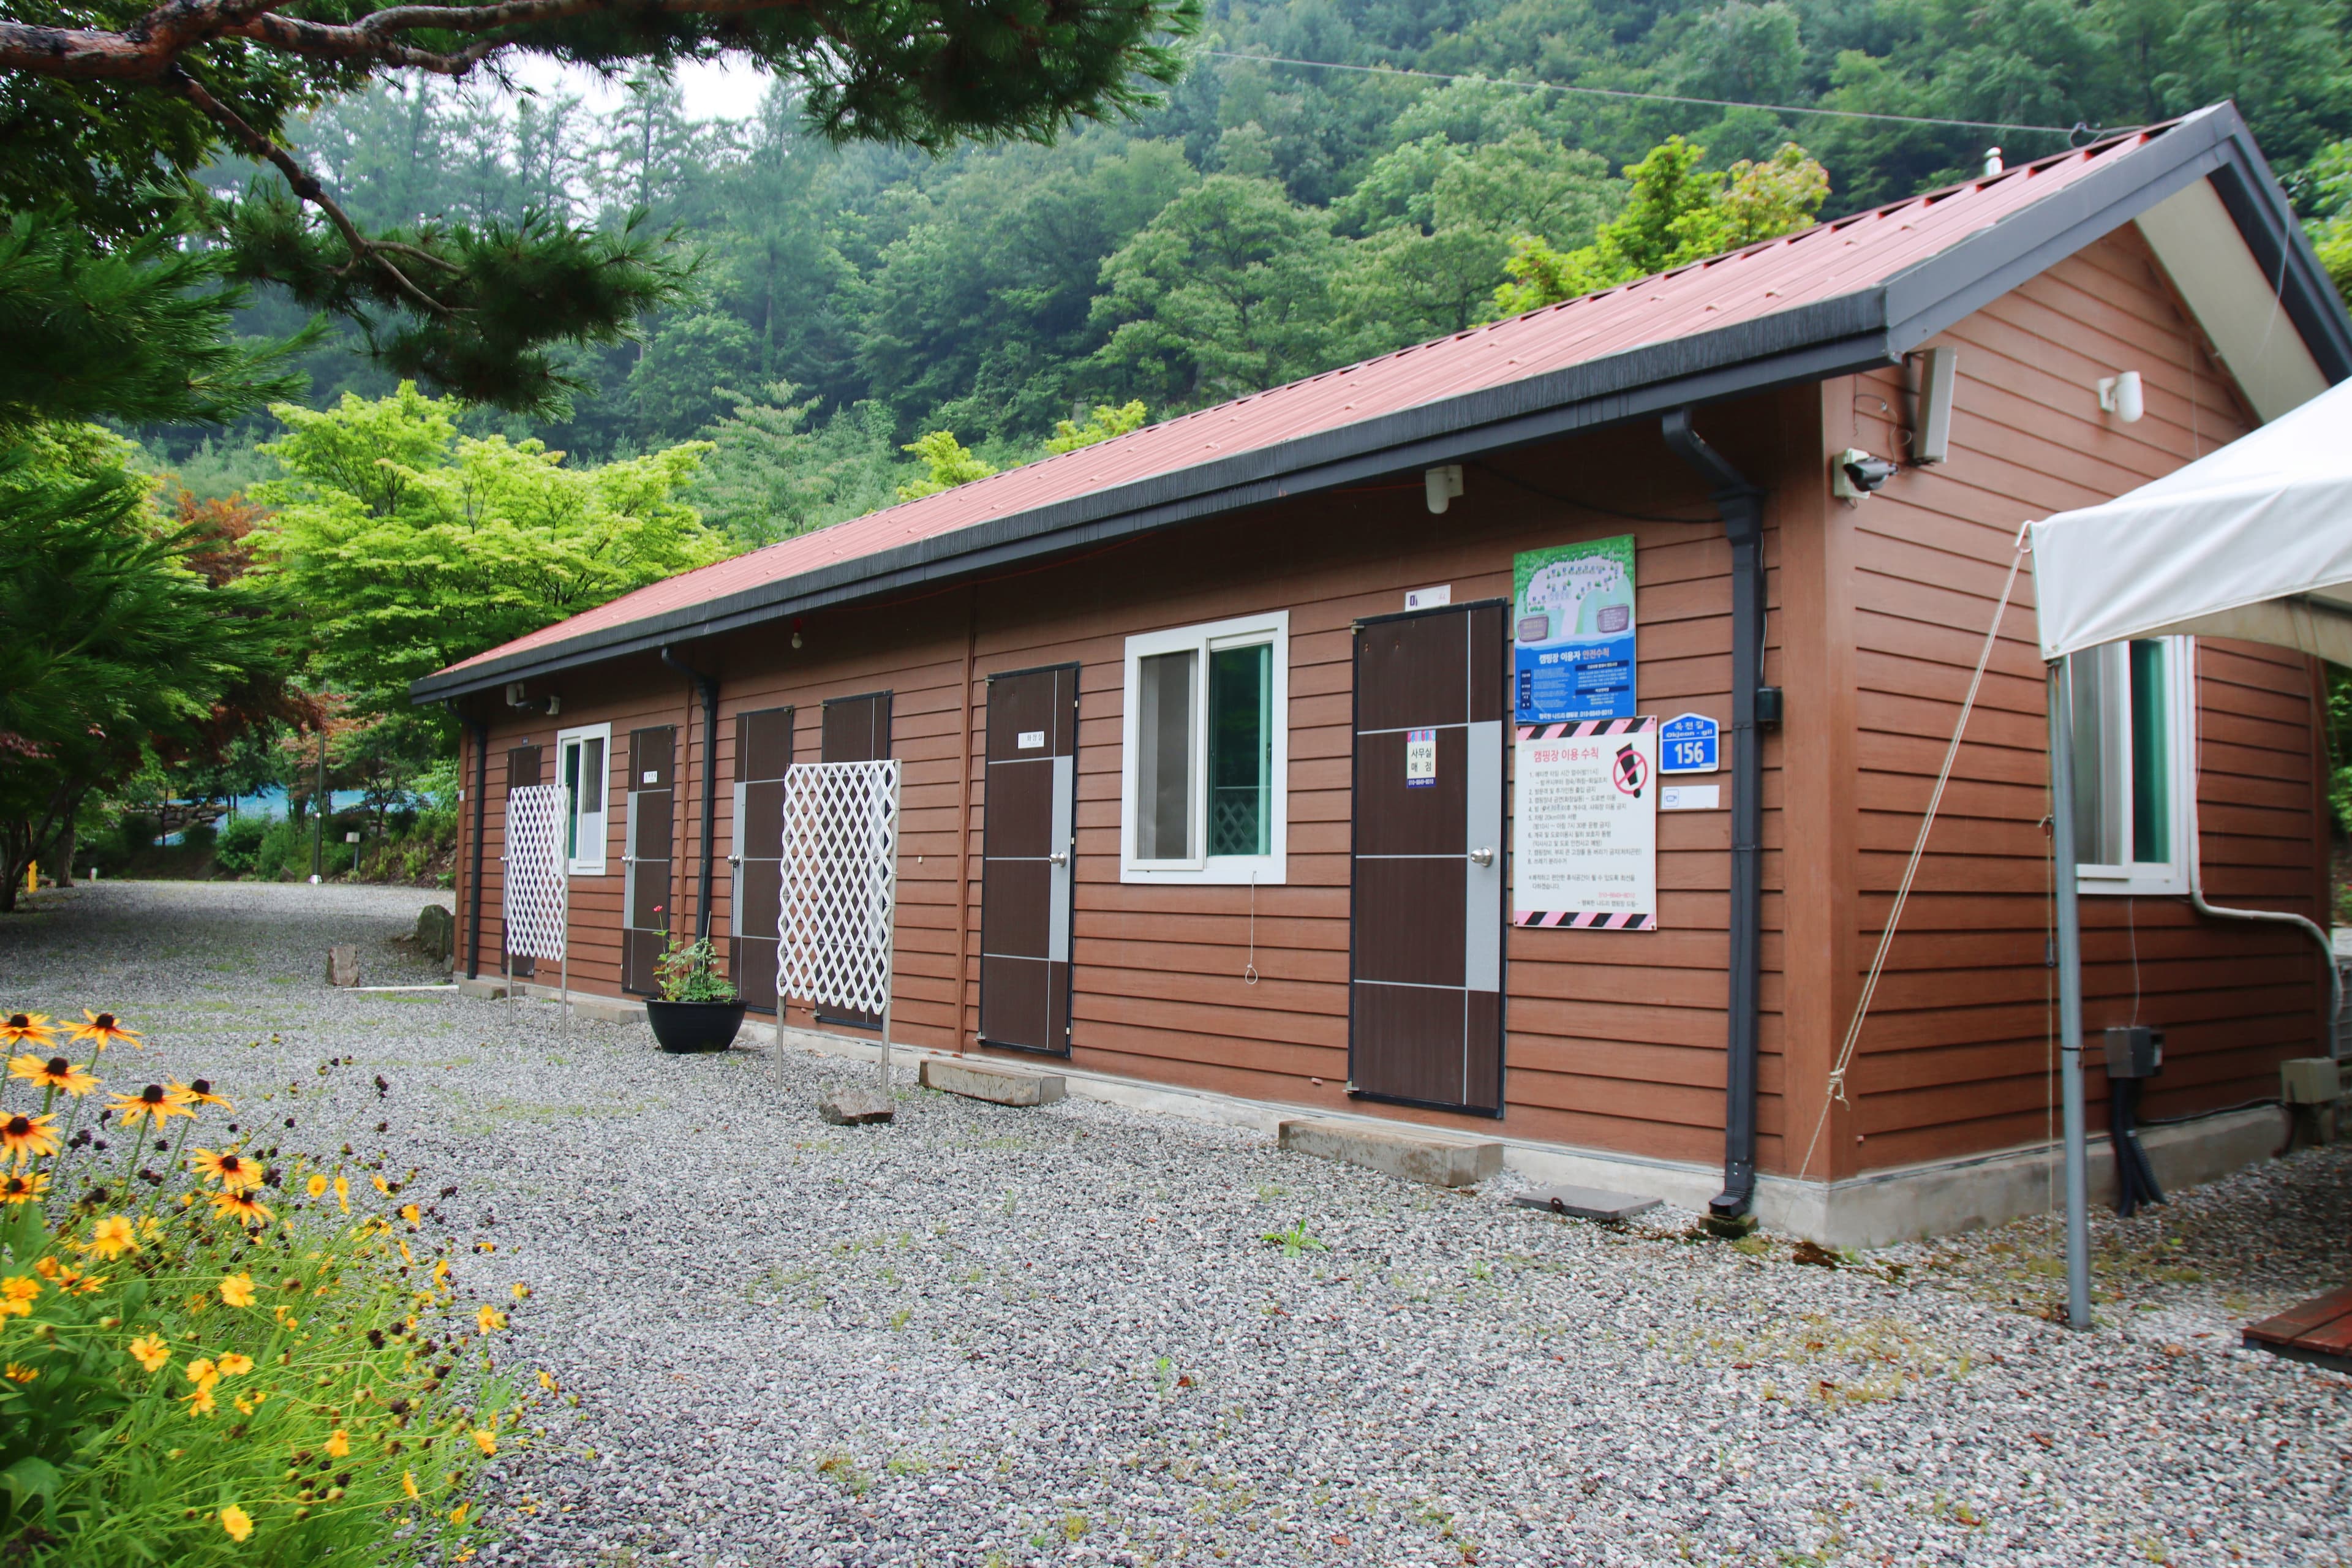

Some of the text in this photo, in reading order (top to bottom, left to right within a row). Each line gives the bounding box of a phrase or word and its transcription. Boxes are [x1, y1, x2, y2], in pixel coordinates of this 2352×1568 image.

[1539, 647, 1609, 664] 캠핑장 이용자 안전수칙
[1675, 721, 1704, 731] 옥전길
[1411, 748, 1431, 758] 사무실
[1534, 747, 1599, 763] 캠핑장 이용 수칙
[1675, 741, 1704, 764] 156
